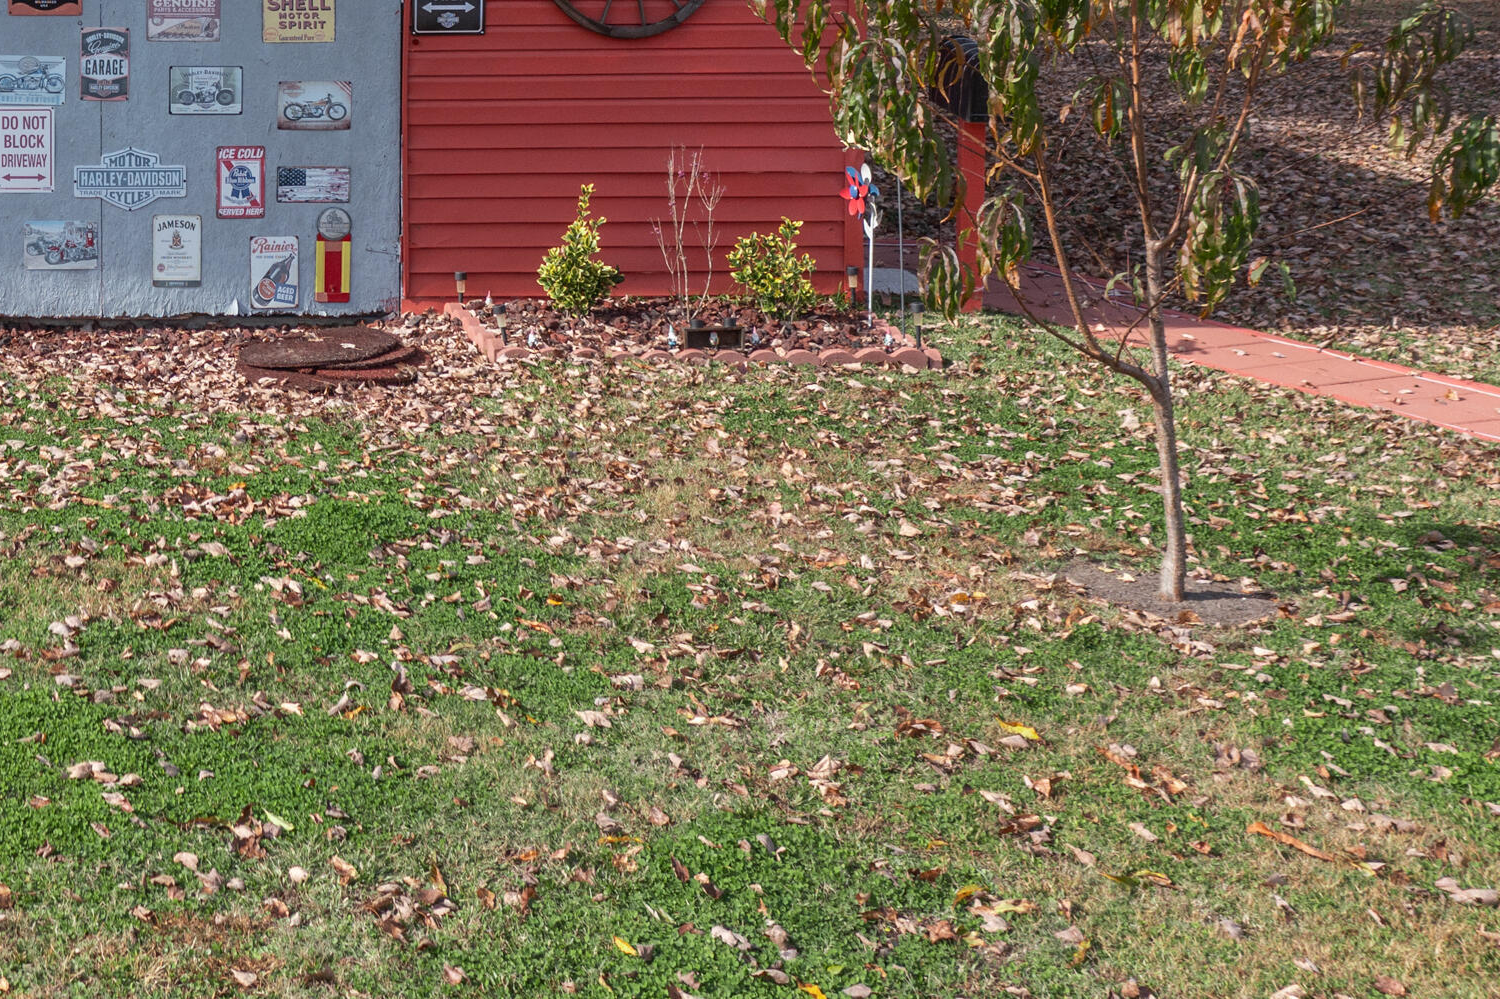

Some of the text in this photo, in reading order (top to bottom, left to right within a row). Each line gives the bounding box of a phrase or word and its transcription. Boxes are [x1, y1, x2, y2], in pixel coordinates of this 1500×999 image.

[153, 0, 216, 8] GENUINE
[278, 21, 326, 29] SPIRIT
[85, 59, 124, 75] GARAGE
[1, 116, 47, 130] DO NOT
[4, 135, 45, 148] BLOCK
[109, 153, 151, 167] MOTOR
[218, 148, 264, 159] ICE COLD
[1, 154, 47, 168] DRIVEWAY
[80, 172, 180, 186] HARLEY-DAVIDSON
[109, 191, 151, 205] CYCLES
[218, 208, 264, 216] SERVED HERE
[157, 219, 197, 232] JAMESON
[252, 238, 298, 254] Rainier
[276, 293, 294, 301] BEER
[277, 286, 295, 295] AGED
